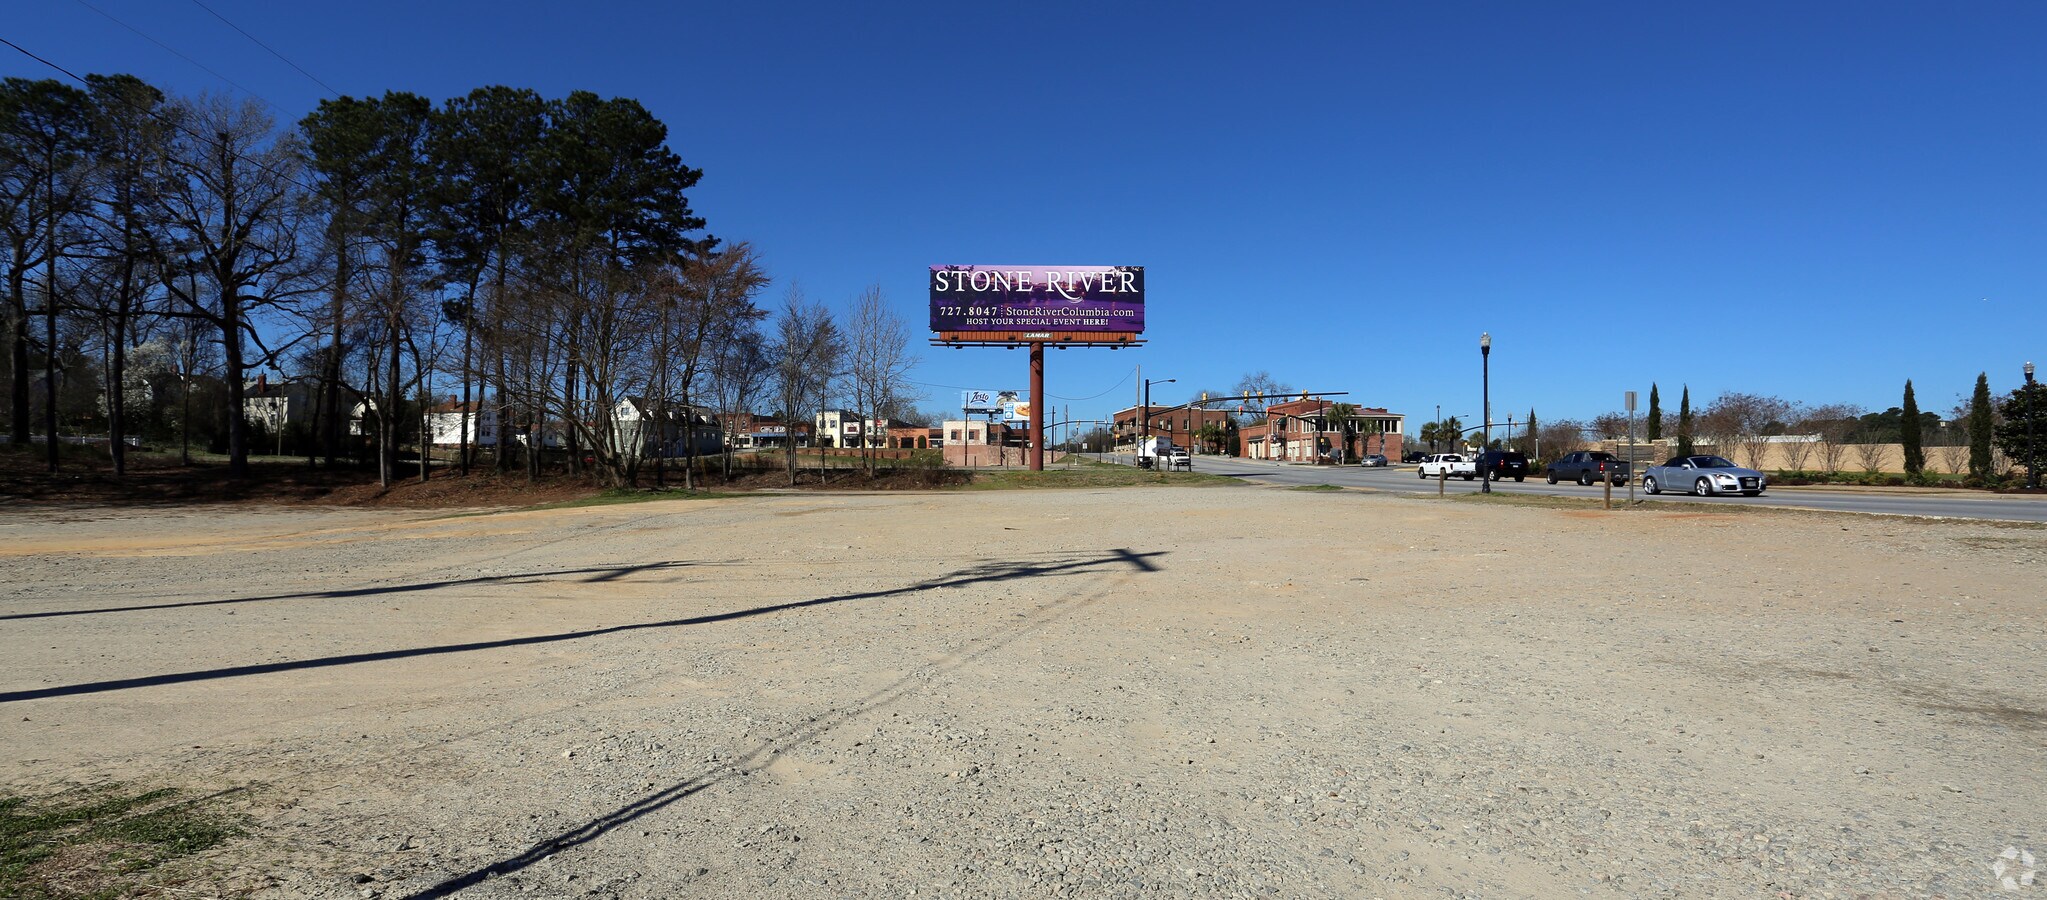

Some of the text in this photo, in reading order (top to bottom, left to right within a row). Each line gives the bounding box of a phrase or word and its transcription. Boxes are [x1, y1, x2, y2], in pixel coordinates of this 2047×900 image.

[935, 271, 1138, 303] STONE RIVER
[940, 306, 1135, 317] 727.8047 StoneRiverColumbia.com
[966, 318, 1109, 326] HOST YOUR SPECIAL EVENT HERE!
